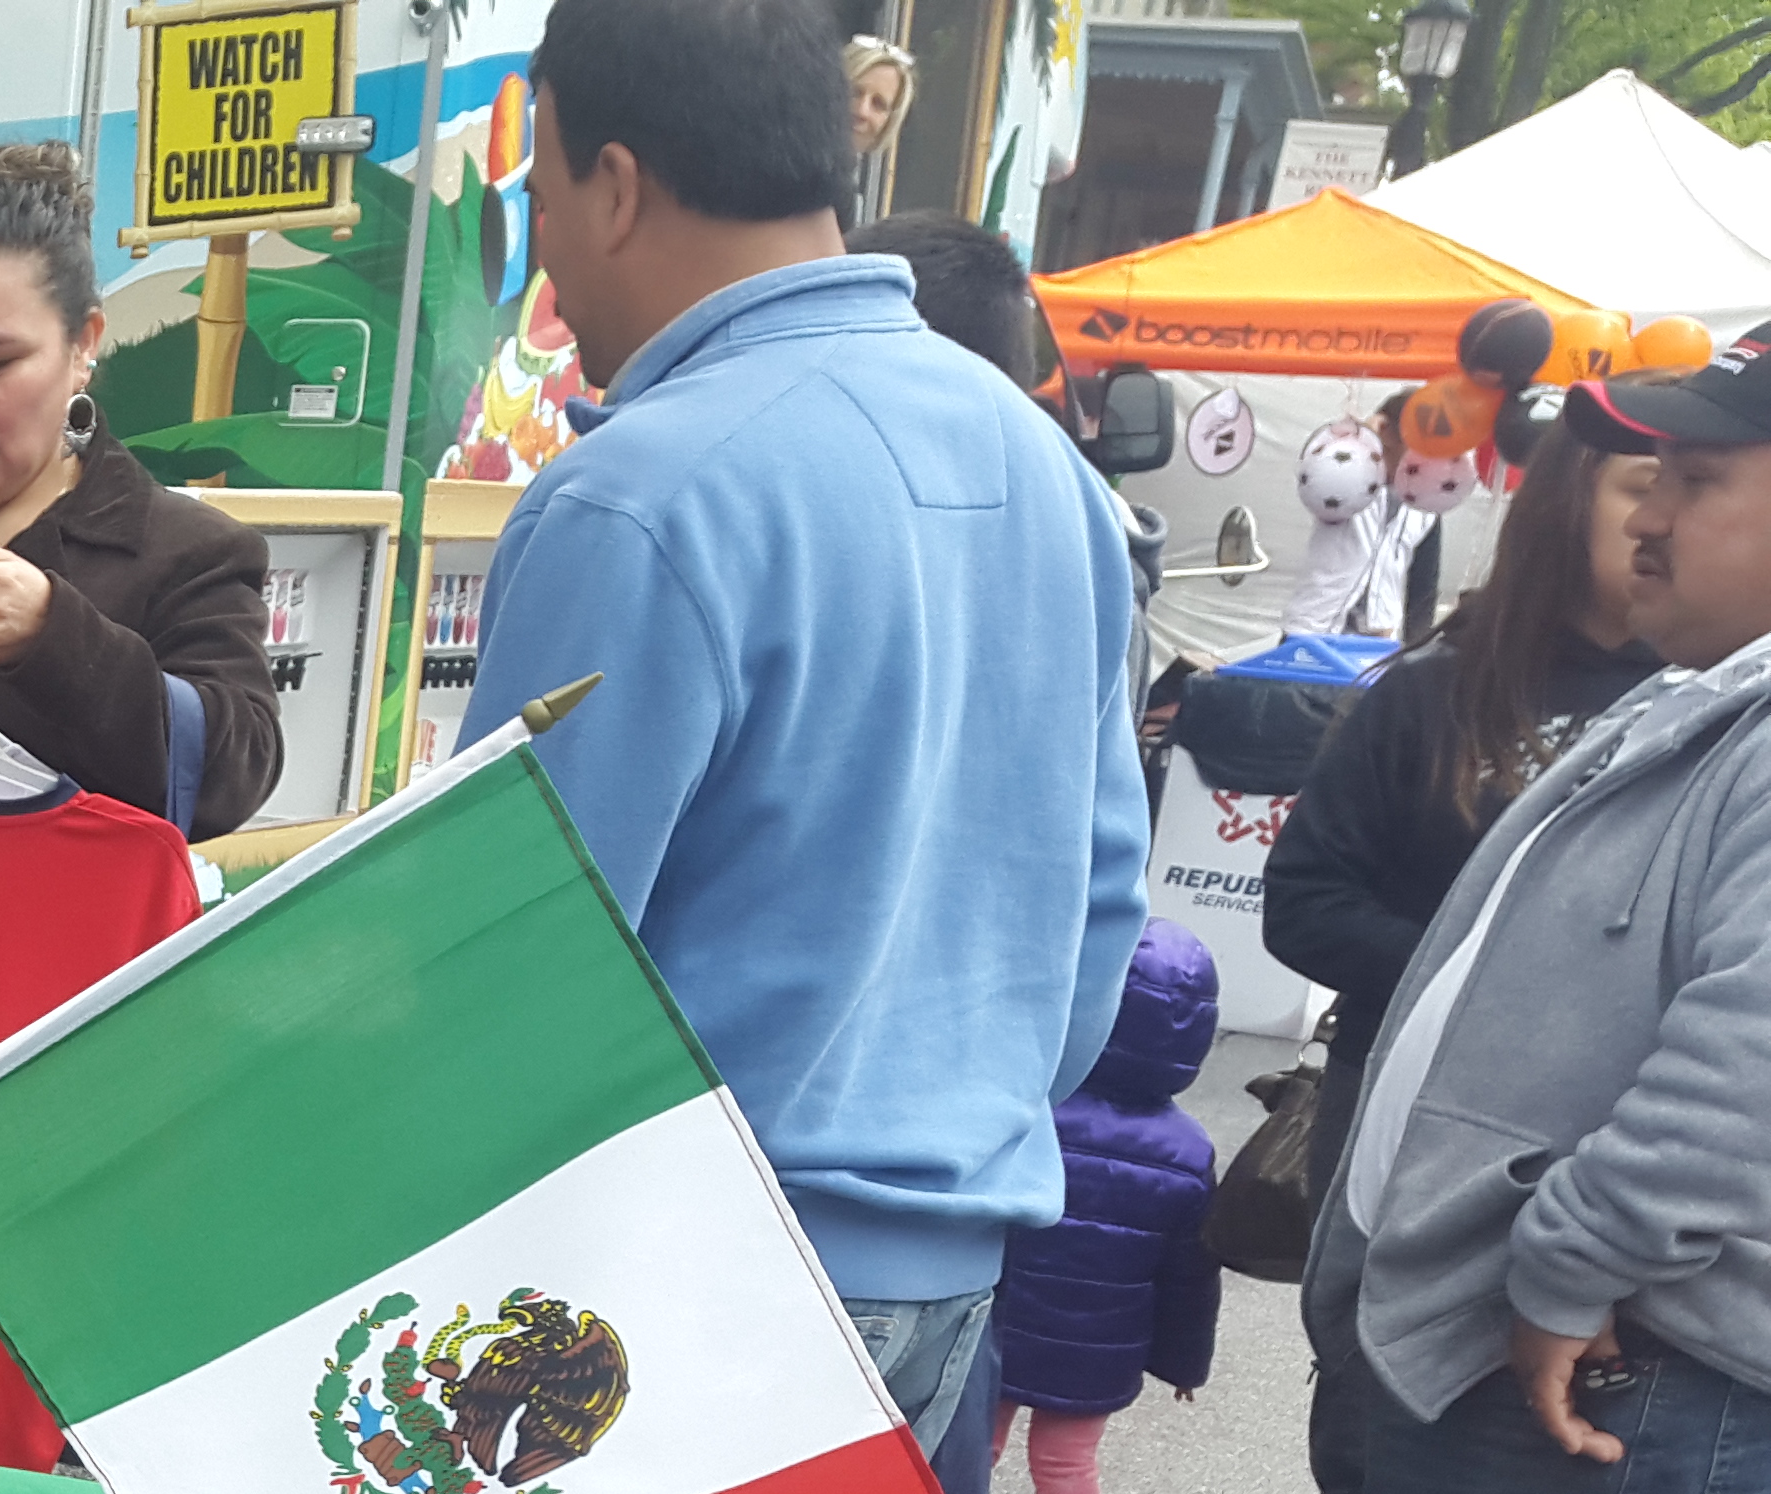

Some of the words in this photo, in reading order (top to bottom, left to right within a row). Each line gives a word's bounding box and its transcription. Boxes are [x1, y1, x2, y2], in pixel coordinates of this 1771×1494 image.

[188, 28, 305, 90] WATCH
[213, 88, 274, 144] FOR
[163, 141, 321, 204] CHILDREN
